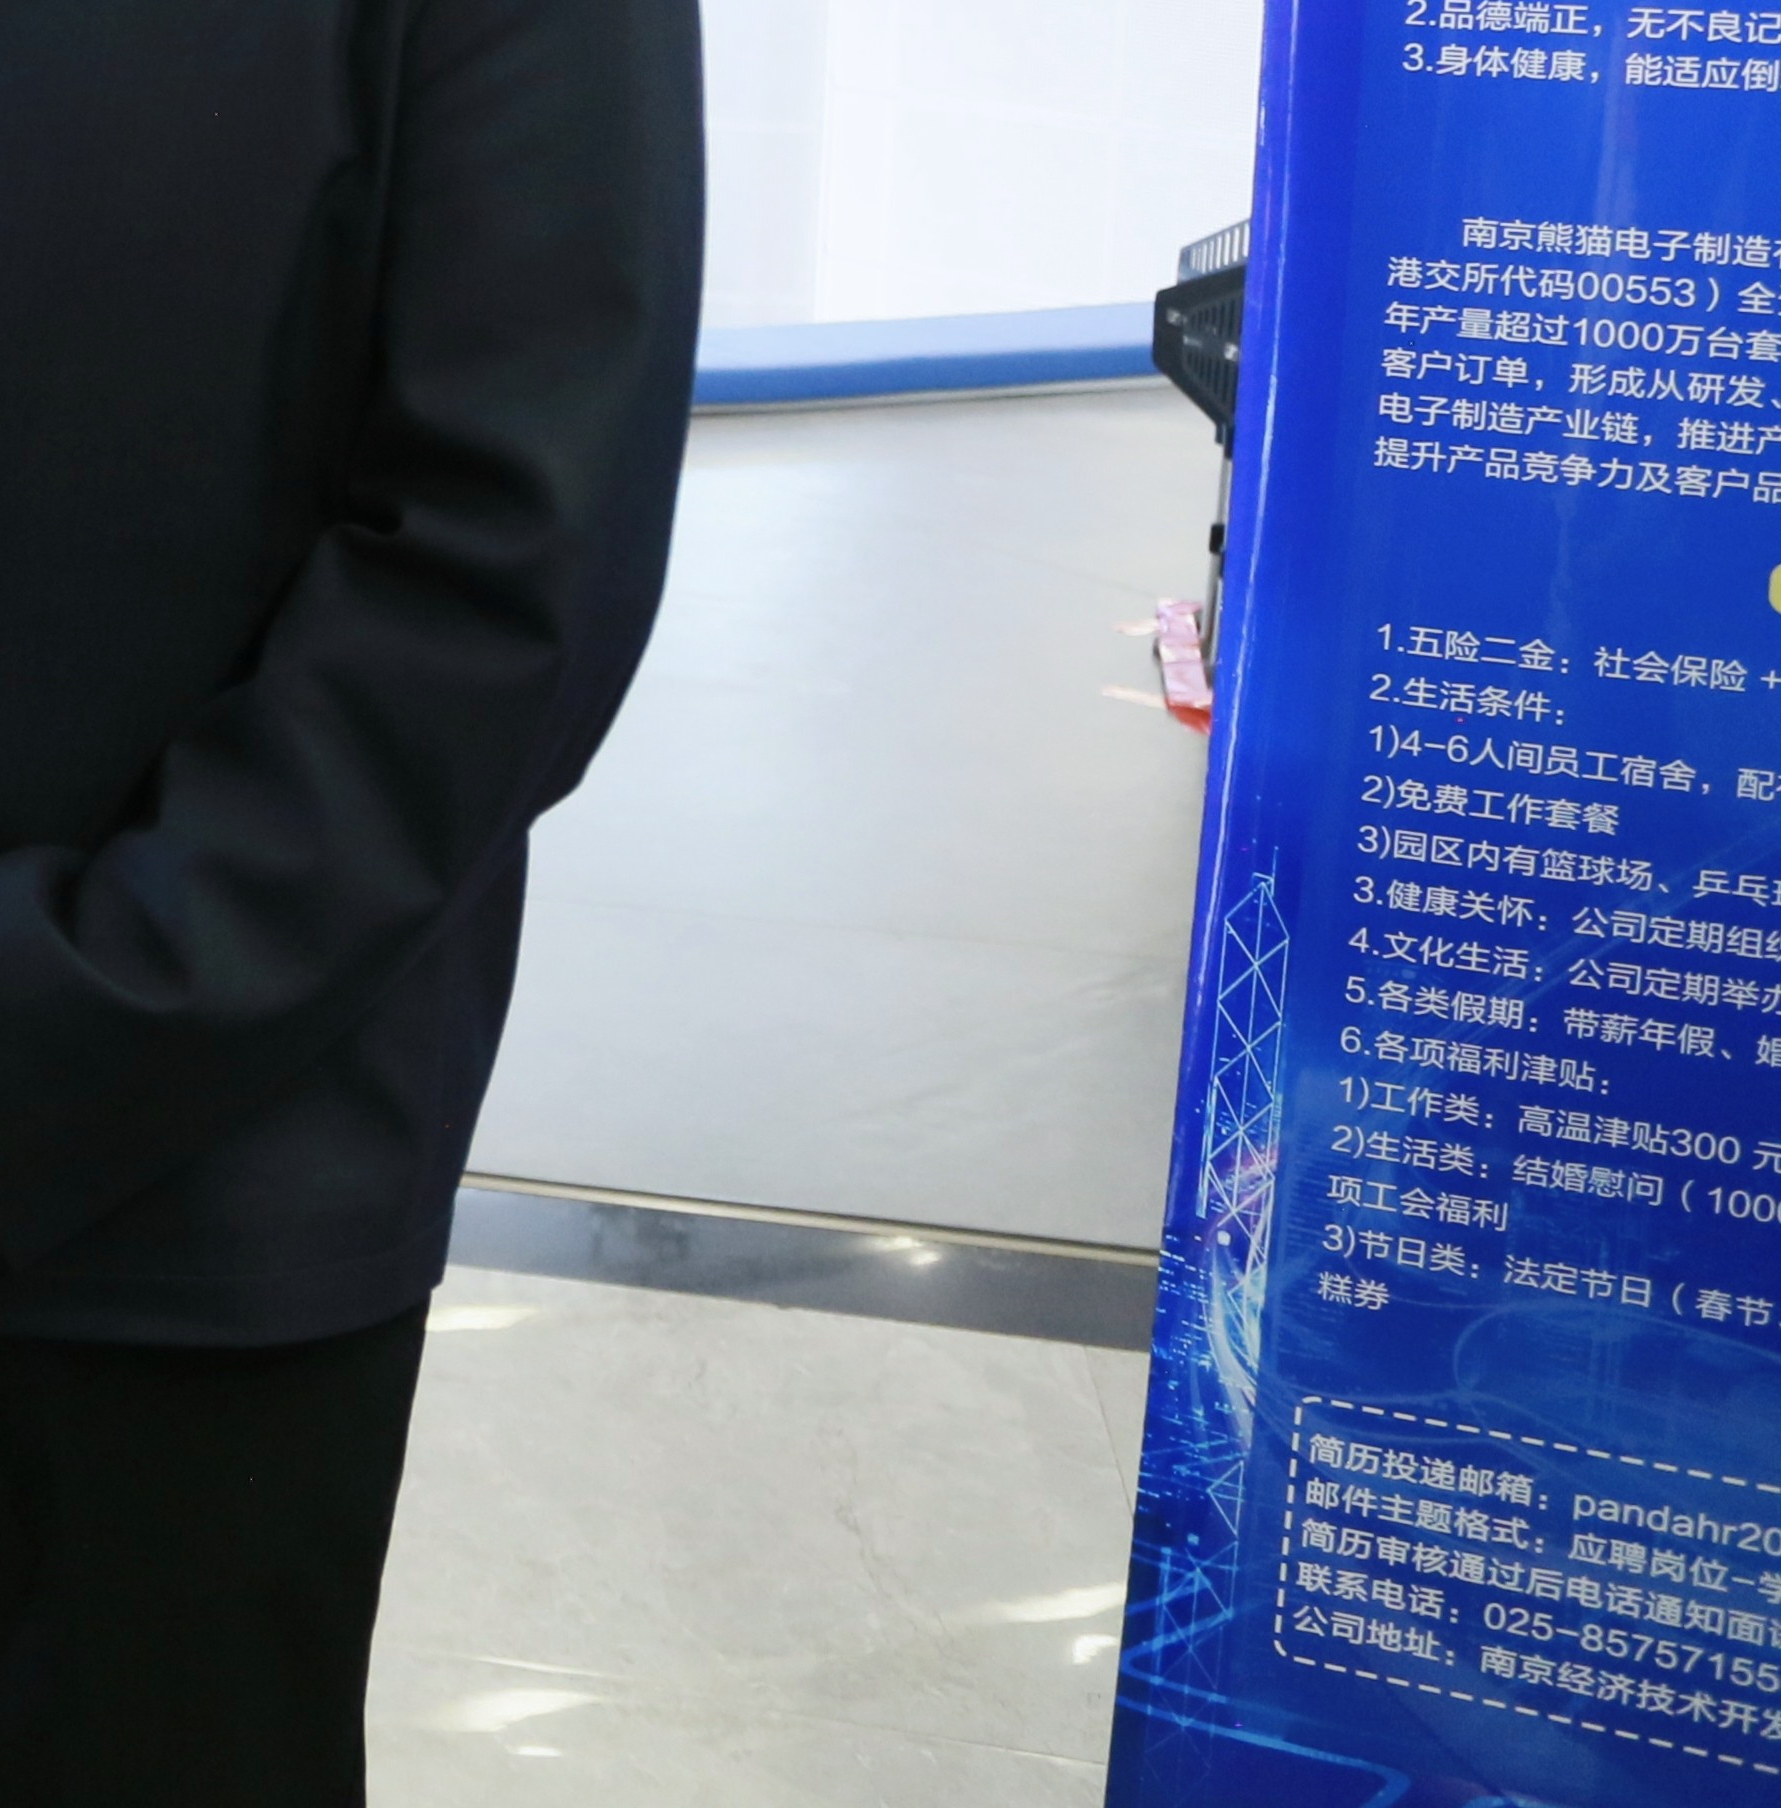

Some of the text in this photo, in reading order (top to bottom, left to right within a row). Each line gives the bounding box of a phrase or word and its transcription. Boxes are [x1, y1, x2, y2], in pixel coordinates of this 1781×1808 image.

[1462, 216, 1781, 268] 南京熊猫电子制造
[1387, 256, 1781, 316] 港交所代码00553）全
[1384, 301, 1781, 363] 年产量超过1000万台套
[1378, 393, 1781, 455] 电子制造产业链，推进产
[1374, 436, 1781, 504] 提升产品竞争力及客户品
[1369, 674, 1565, 725] 2.生活条件：
[1369, 725, 1781, 802] 1)4-6人间员工宿舍，配
[1360, 775, 1620, 836] 2)免费工作套餐
[1357, 825, 1781, 908] 3)园区内有篮球场、乒乓
[1340, 1027, 1610, 1095] 6.各项福利津贴：
[1327, 1175, 1509, 1232] 项工会福利
[1331, 1126, 1781, 1223] 2)生活类：结婚慰问（100
[1318, 1272, 1390, 1312] 糕券
[1322, 1224, 1781, 1328] 3)节日类：法定节日（春节
